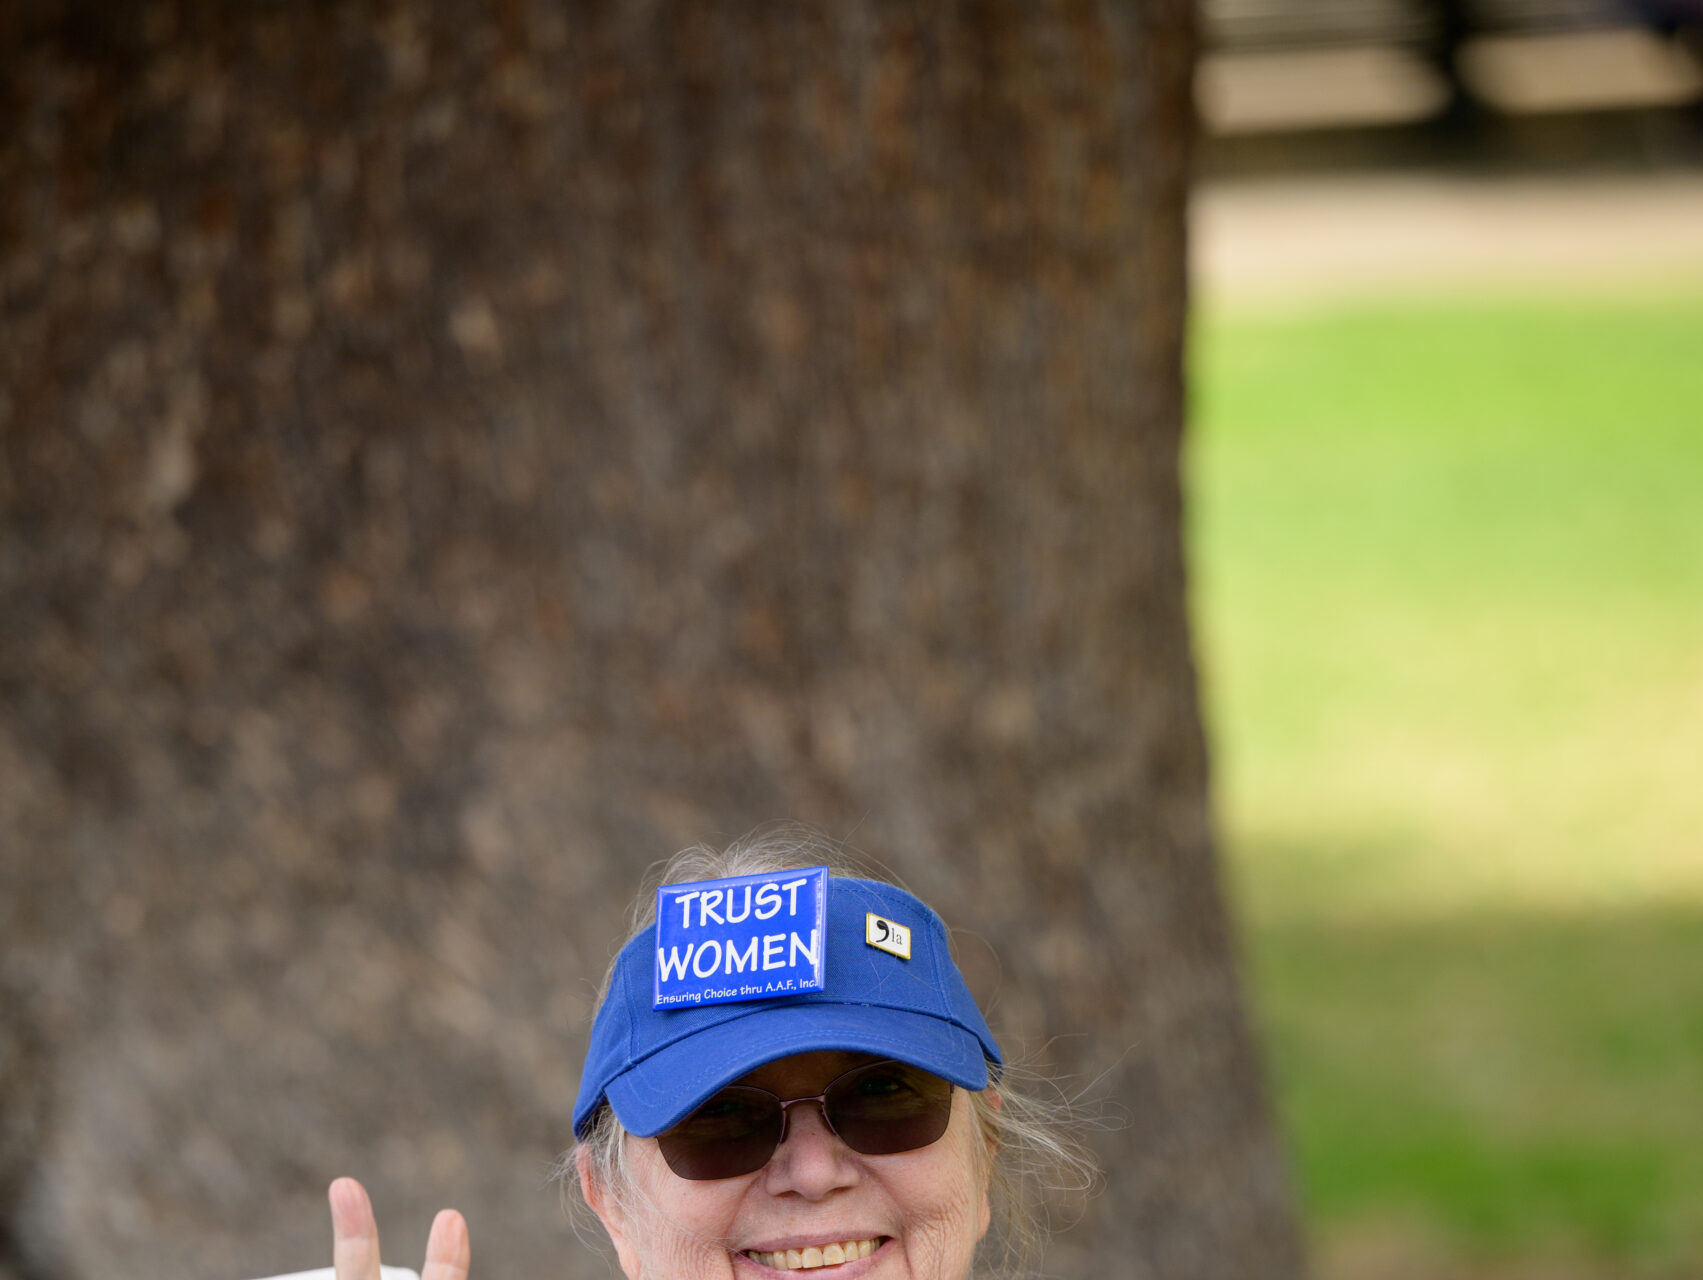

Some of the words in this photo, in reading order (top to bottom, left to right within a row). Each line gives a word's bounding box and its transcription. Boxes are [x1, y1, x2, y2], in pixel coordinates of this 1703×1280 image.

[675, 878, 807, 929] TRUST
[657, 928, 818, 983] WOMEN
[656, 991, 701, 1005] Ensuring
[703, 987, 738, 1000] Choice
[740, 985, 762, 996] thru
[799, 979, 819, 989] Inc.
